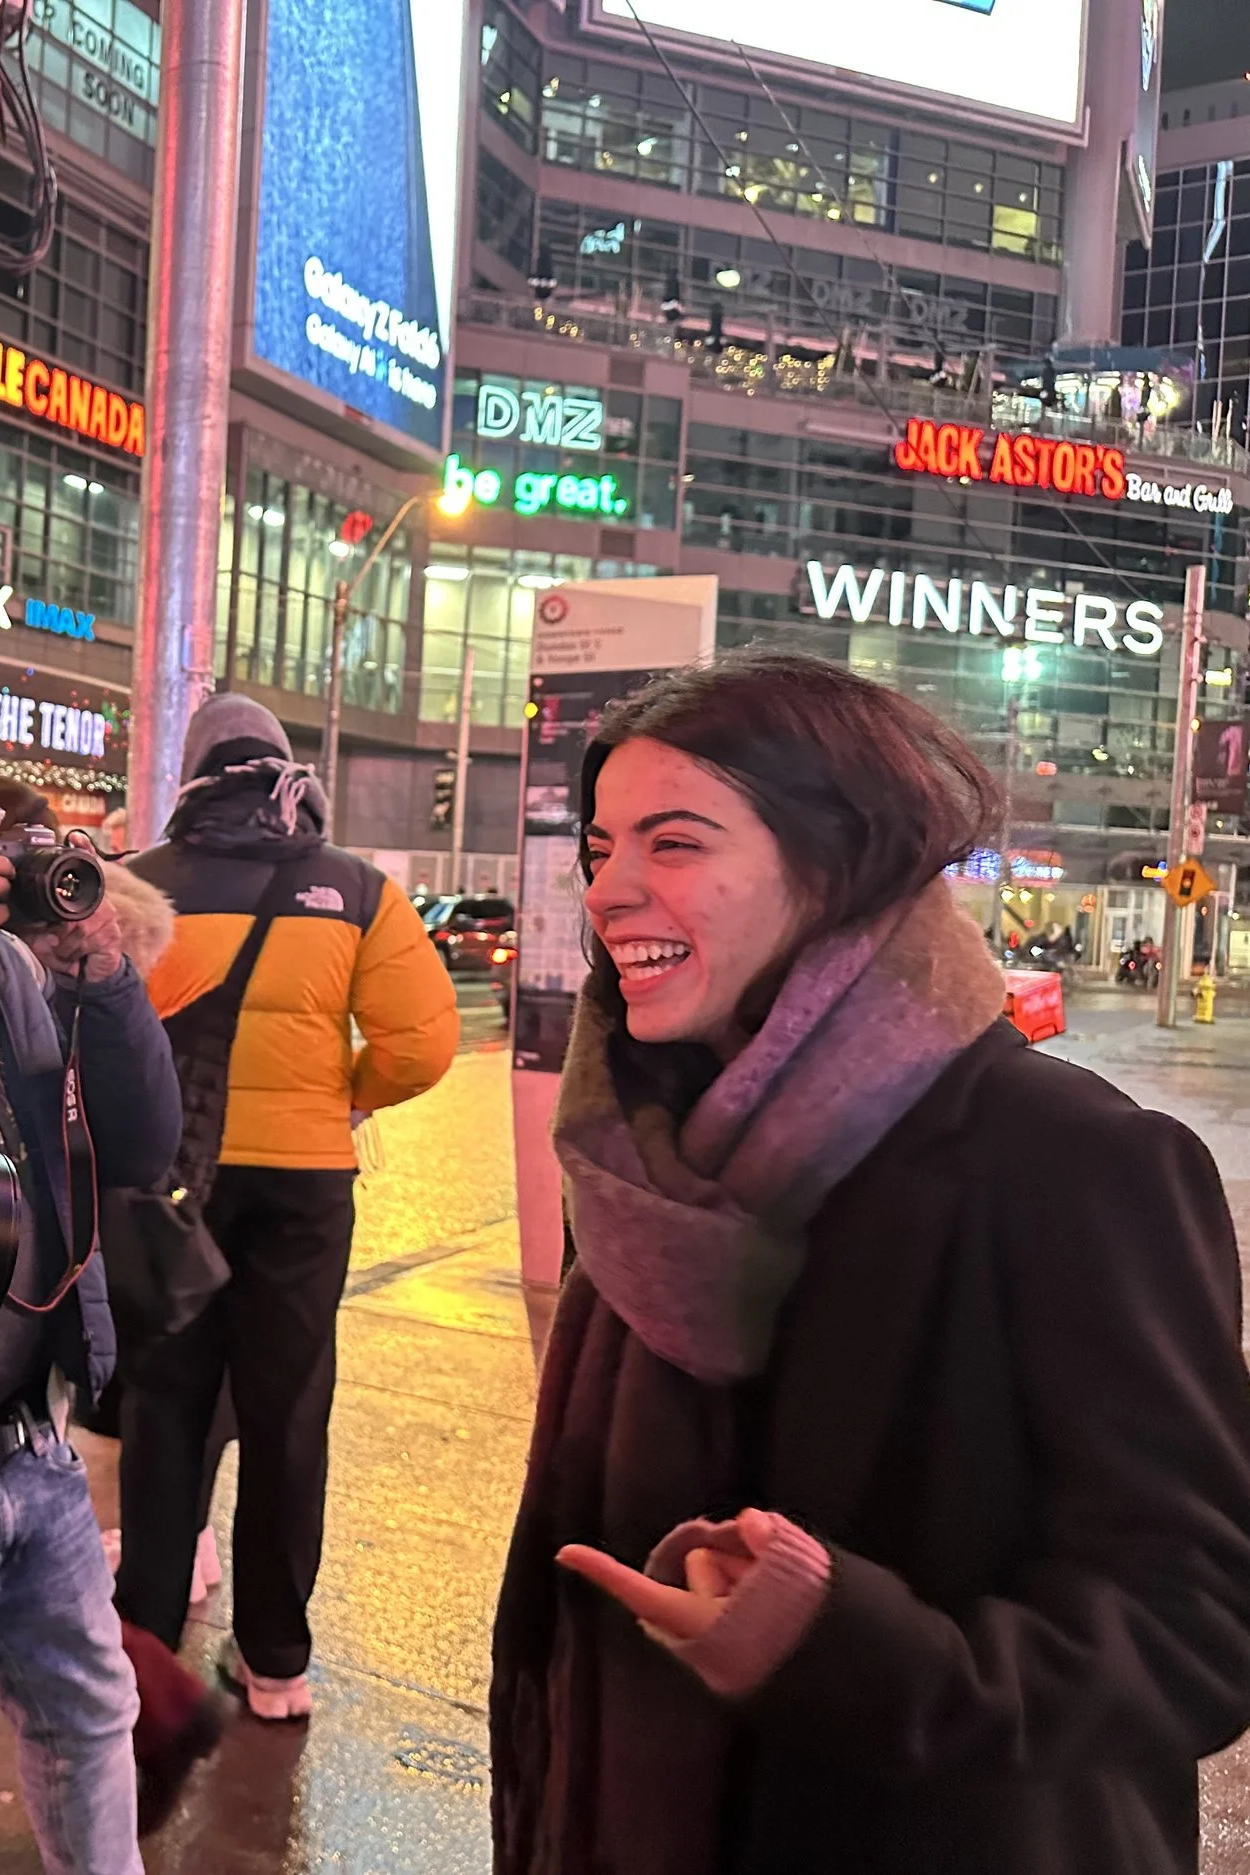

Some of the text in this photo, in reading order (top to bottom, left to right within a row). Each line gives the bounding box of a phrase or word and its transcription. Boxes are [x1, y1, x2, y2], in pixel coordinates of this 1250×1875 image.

[73, 21, 144, 90] COMING
[84, 72, 134, 126] SOON
[24, 358, 146, 458] CANADA
[477, 385, 604, 451] DMZ
[441, 452, 628, 516] be great.
[895, 417, 1234, 514] JACK ASTOR'S Bar and Grill
[25, 597, 96, 642] IMAX
[806, 560, 1165, 656] WINNERS
[38, 701, 106, 758] TENOR
